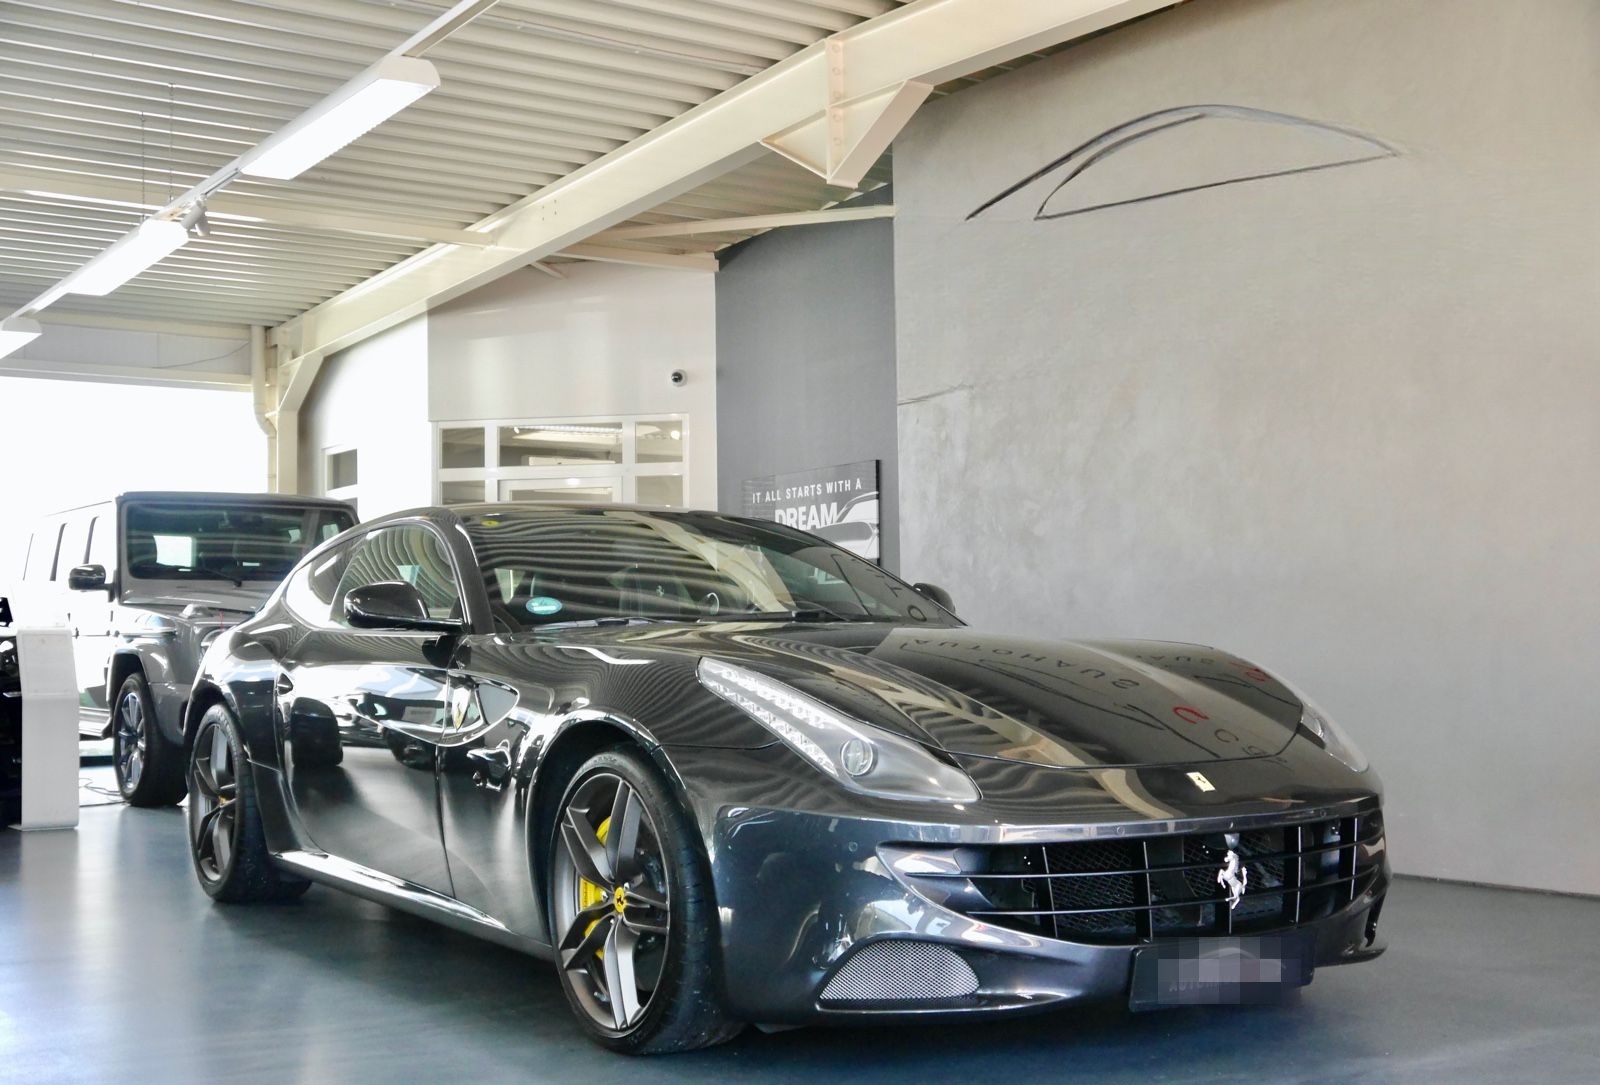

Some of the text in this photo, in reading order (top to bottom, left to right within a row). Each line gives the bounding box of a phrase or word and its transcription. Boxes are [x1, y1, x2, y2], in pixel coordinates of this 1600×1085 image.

[752, 478, 862, 504] IT ALL STARTS WITH A
[774, 502, 837, 531] DREAM
